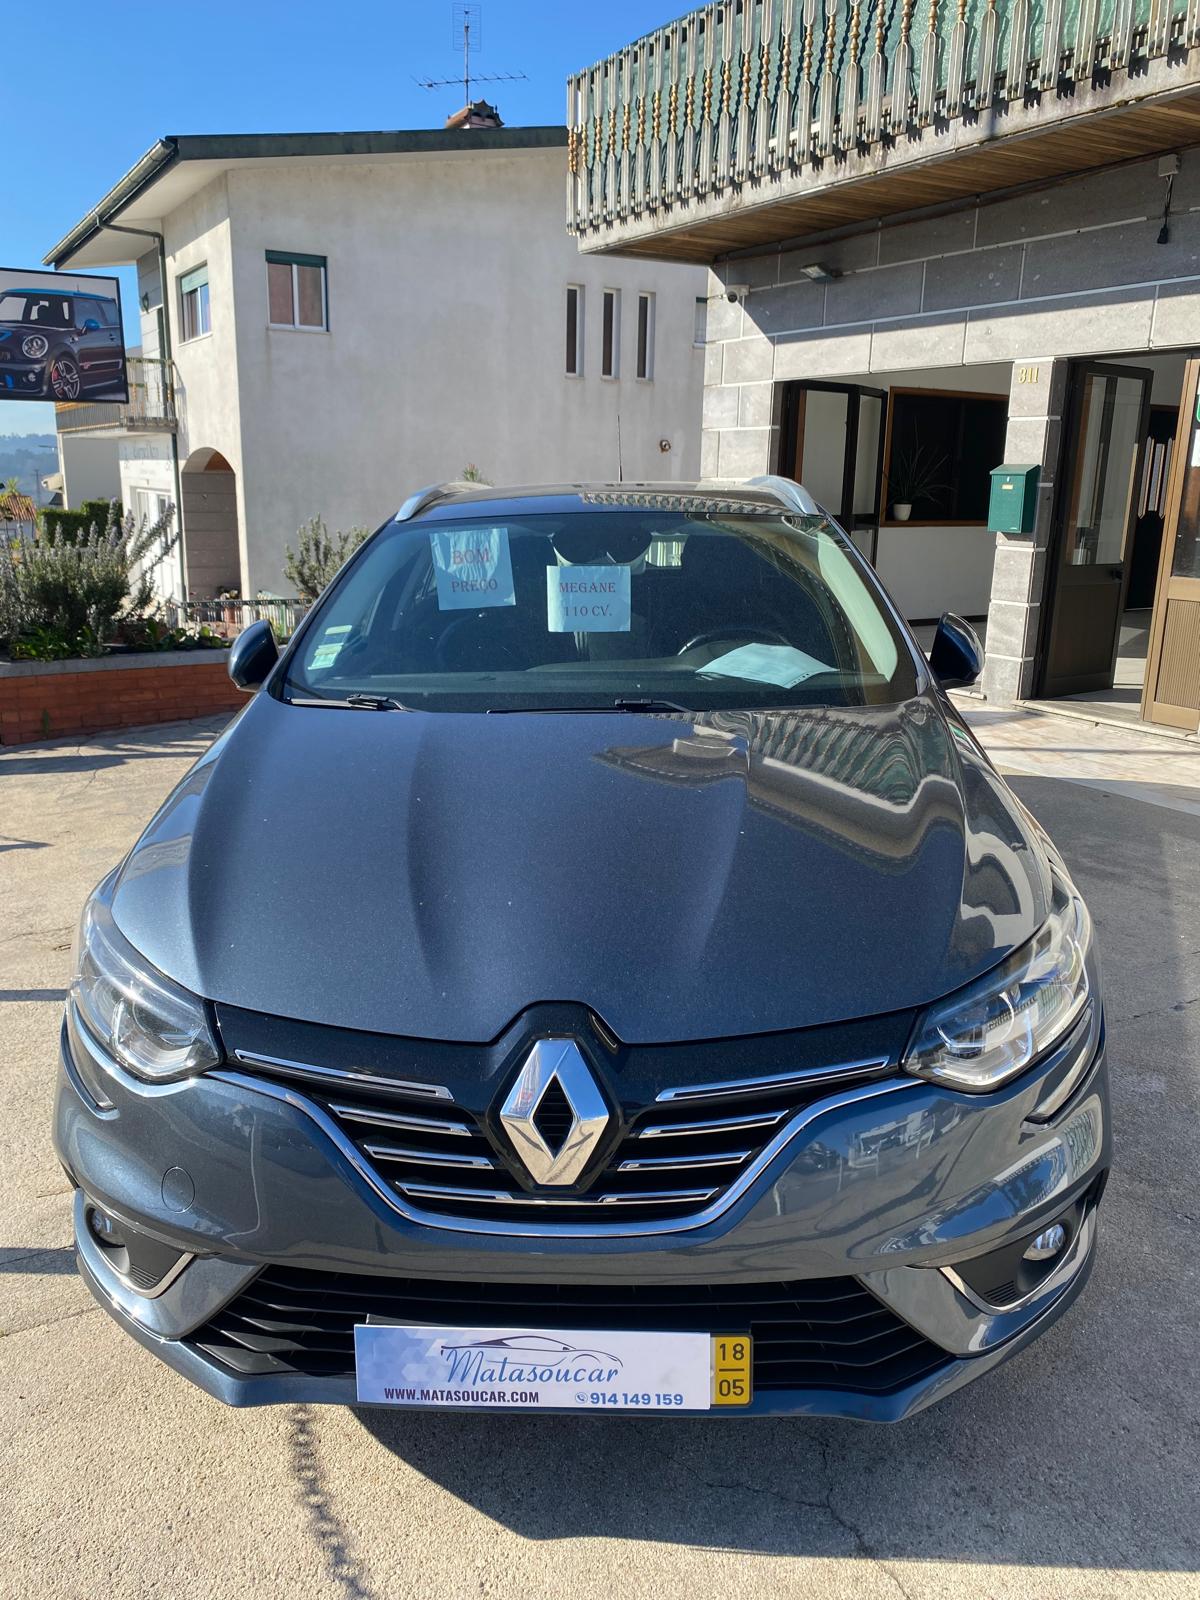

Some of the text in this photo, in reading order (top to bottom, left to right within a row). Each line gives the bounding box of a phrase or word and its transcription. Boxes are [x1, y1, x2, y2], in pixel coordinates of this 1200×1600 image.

[452, 548, 490, 565] BOM
[451, 578, 498, 594] PREÇO
[559, 582, 616, 593] MEGANE
[564, 605, 613, 617] 110 CV.
[719, 1343, 745, 1362] 18
[446, 1349, 618, 1386] Matasoucar
[384, 1388, 539, 1403] WWW.MATASOUCAR.COM
[718, 1379, 745, 1397] 05
[590, 1392, 684, 1406] 914 149 159
